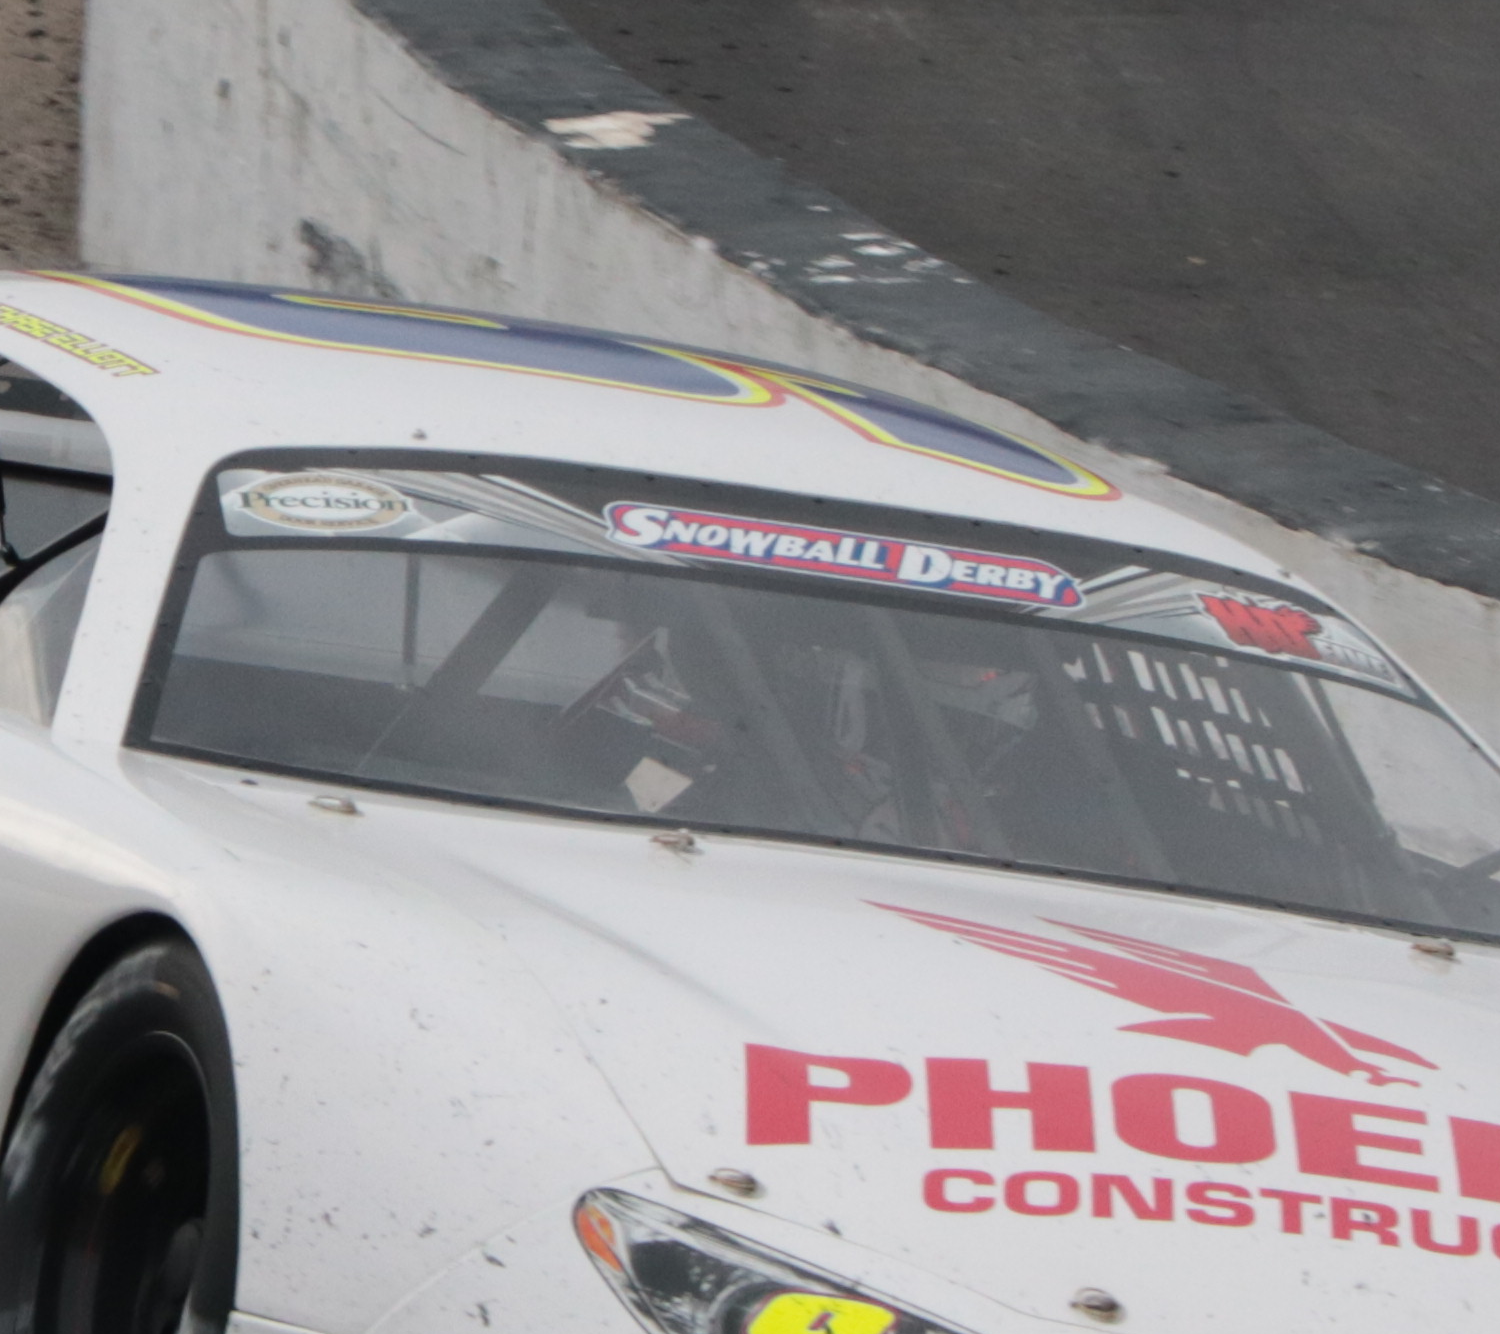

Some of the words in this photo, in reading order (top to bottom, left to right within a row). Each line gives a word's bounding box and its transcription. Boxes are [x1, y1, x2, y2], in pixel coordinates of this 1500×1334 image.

[41, 332, 161, 377] ELLIOTT
[237, 490, 411, 512] Precision
[613, 505, 885, 571] SNOWBALL
[897, 543, 1073, 602] DERBY
